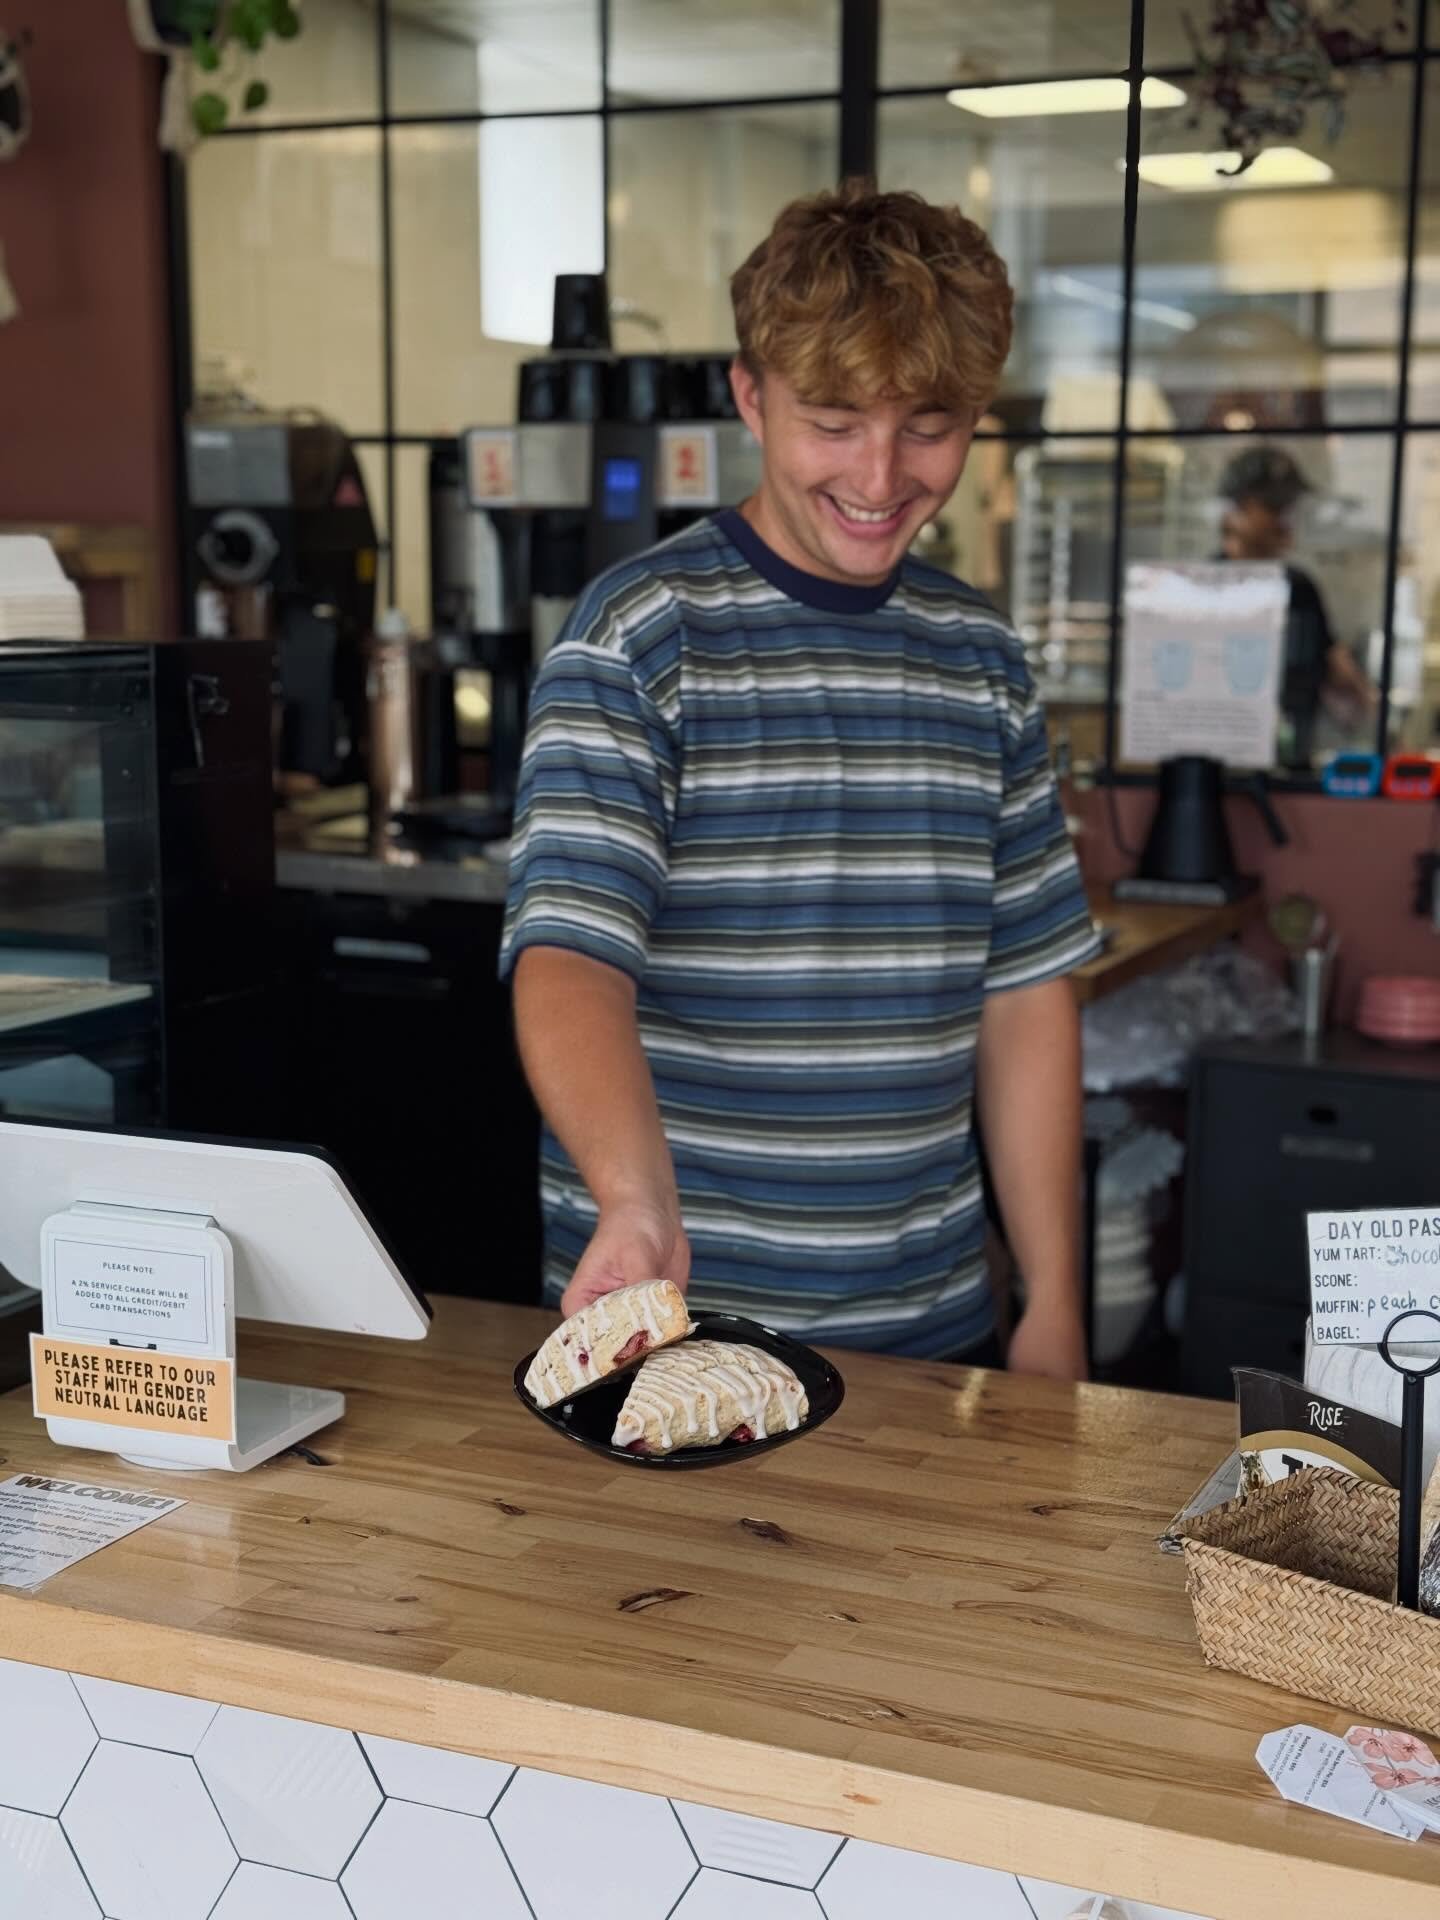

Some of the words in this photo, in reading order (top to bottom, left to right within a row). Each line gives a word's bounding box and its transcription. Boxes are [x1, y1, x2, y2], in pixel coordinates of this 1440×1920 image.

[1328, 1221, 1363, 1240] DAY
[1371, 1219, 1403, 1239] OLD
[1409, 1217, 1440, 1237] PAS
[1313, 1247, 1341, 1262] YUM
[1344, 1246, 1381, 1260] TART:
[102, 1261, 131, 1272] PLEASE
[91, 1281, 122, 1292] SERVICE
[124, 1285, 156, 1296] CHARGE
[157, 1289, 177, 1299] WILL
[178, 1291, 189, 1300] BE
[1314, 1273, 1358, 1288] SCONE:
[75, 1289, 102, 1300] ADDED
[103, 1293, 114, 1301] TO
[115, 1294, 130, 1303] ALL
[131, 1296, 186, 1310] CREDIT/DEBIT
[89, 1302, 111, 1311] CARD
[112, 1304, 172, 1319] TRANSACTIONS
[1315, 1299, 1364, 1314] MUFFIN:
[1367, 1289, 1417, 1318] peach
[1317, 1326, 1360, 1340] BAGEL:
[44, 1349, 100, 1371] PLEASE
[105, 1358, 154, 1379] REFER
[159, 1364, 178, 1382] TO
[184, 1368, 216, 1386] OUR
[55, 1369, 99, 1389] STAFF
[104, 1375, 138, 1395] WITH
[144, 1381, 206, 1404] GENDER
[55, 1387, 120, 1411] NEUTRAL
[126, 1397, 208, 1422] LANGUAGE
[1306, 1401, 1344, 1431] RISE
[15, 1475, 175, 1510] WELCOME!
